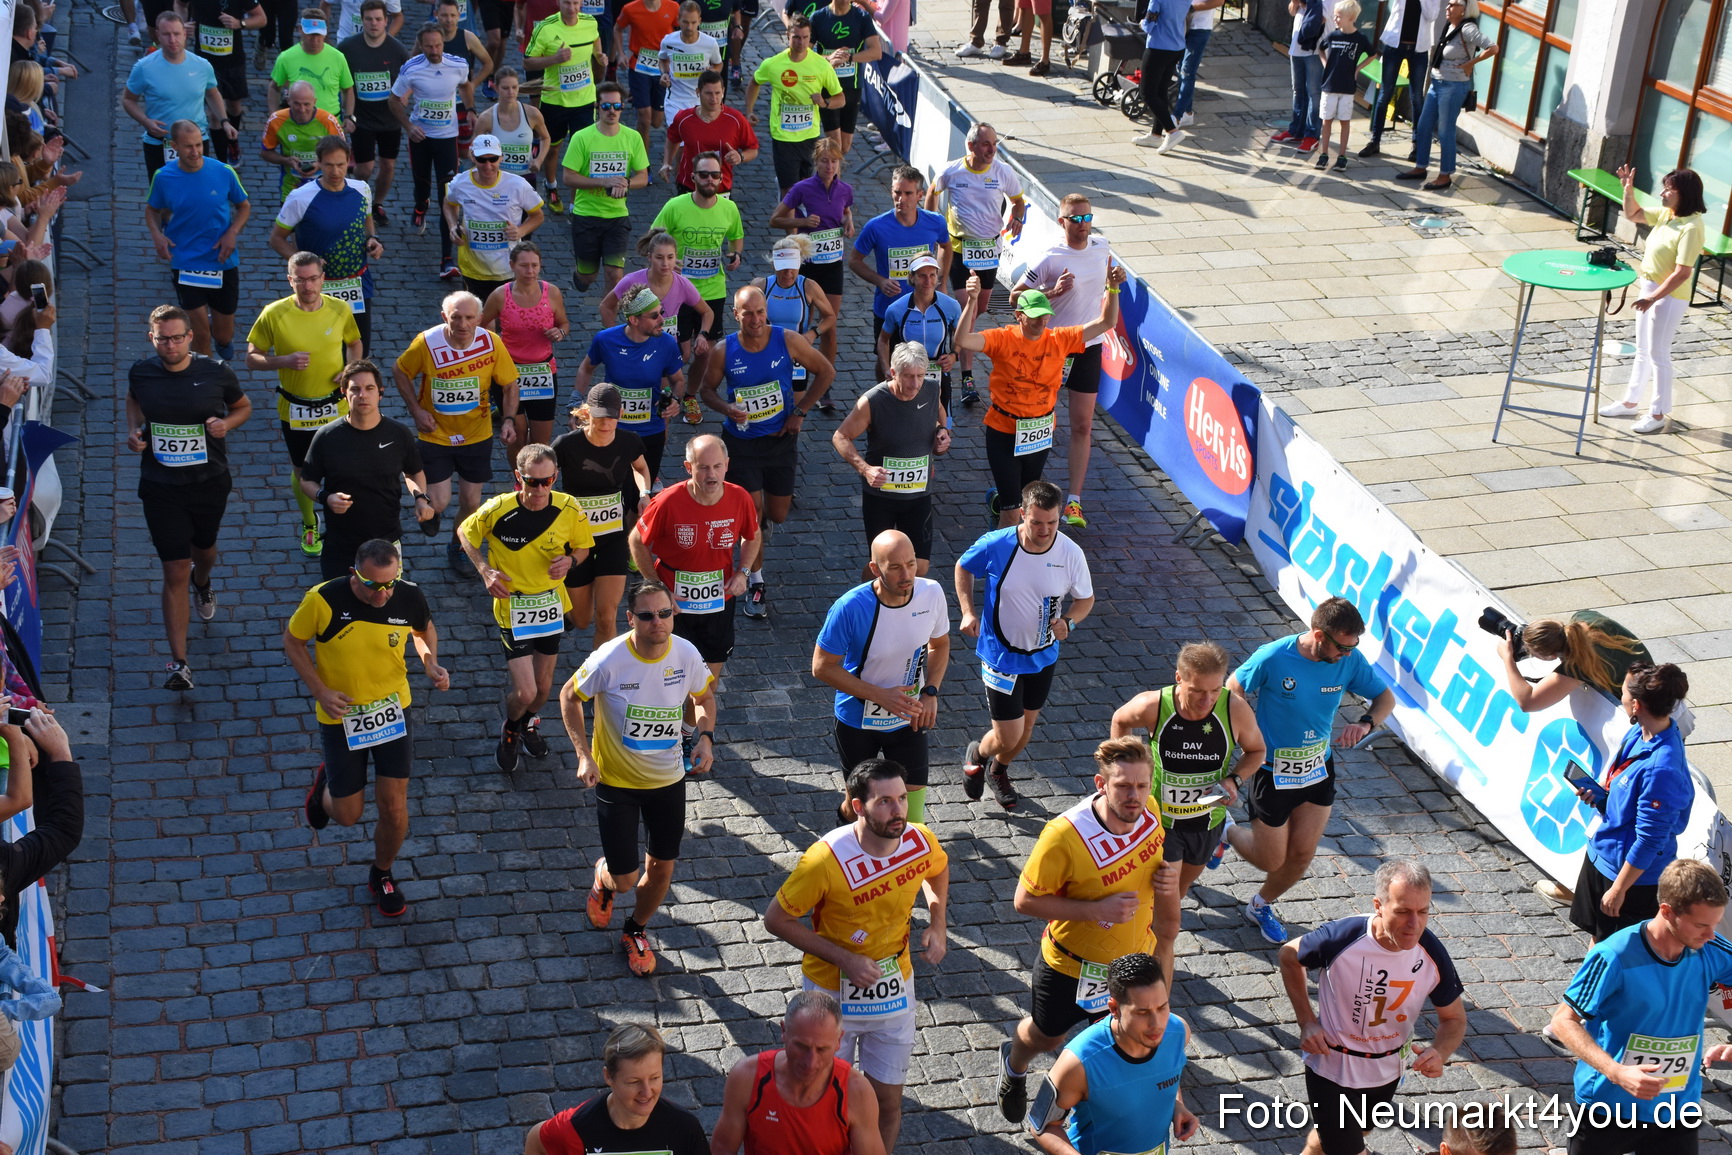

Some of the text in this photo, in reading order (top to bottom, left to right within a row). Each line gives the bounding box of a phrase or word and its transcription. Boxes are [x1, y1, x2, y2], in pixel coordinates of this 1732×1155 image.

[203, 35, 230, 46] 1229
[640, 55, 659, 67] 272
[677, 62, 702, 72] 1142
[560, 62, 588, 74] BOCK
[358, 73, 388, 82] BOCK
[563, 71, 589, 84] 2095
[359, 81, 388, 92] 2823
[421, 101, 451, 110] BOCK
[422, 109, 450, 120] 2297
[785, 113, 811, 123] 2116
[501, 153, 526, 164] 299
[594, 162, 623, 173] 2542
[472, 231, 504, 243] 2353
[815, 239, 841, 253] 2428
[967, 249, 994, 260] 3000
[686, 258, 717, 269] 2543
[434, 378, 477, 390] BOCK
[1149, 363, 1170, 393] ONLINE
[437, 390, 475, 403] 2842
[737, 383, 776, 397] BOCK
[621, 400, 647, 412] 134
[745, 394, 778, 412] 1133
[1146, 389, 1167, 420] MOBILE
[295, 405, 332, 419] 1193
[748, 408, 776, 420] JOCHEN
[300, 418, 329, 427] STEFAN
[1020, 415, 1054, 429] BOCK
[155, 424, 200, 436] BOCK
[1020, 427, 1051, 444] 2609
[1189, 382, 1247, 481] Hervis
[158, 438, 199, 453] 2672
[1018, 440, 1050, 452] CHRISTIAN
[163, 454, 197, 463] MARCEL
[1195, 439, 1219, 471] SPORTS
[885, 457, 925, 469] BOCK
[888, 469, 923, 483] 1197
[579, 496, 616, 507] BOCK
[585, 507, 618, 523] 406
[500, 535, 519, 543] Heinz
[679, 571, 721, 584] BOCK
[680, 584, 719, 600] 3006
[518, 594, 561, 608] BOCK
[687, 602, 713, 610] JOSEF
[517, 606, 559, 625] 2798
[1320, 685, 1343, 693] BOCK
[350, 707, 398, 733] 2608
[631, 707, 680, 720] BOCK
[358, 727, 397, 743] MARKUS
[629, 722, 675, 738] 2794
[1303, 729, 1317, 739] 18.
[1182, 741, 1203, 750] DAV
[1280, 743, 1323, 758] BOCK
[1164, 750, 1220, 761] Röthenbach
[1280, 755, 1321, 775] 2550
[1166, 774, 1216, 786] BOCK
[1278, 769, 1322, 784] CHRISTIAN
[1168, 786, 1212, 804] 122
[1167, 805, 1211, 814] REINHAR
[1101, 834, 1165, 887] MAX BÖGL
[853, 859, 933, 906] MAX BÖGL
[848, 977, 901, 1001] 2409
[1362, 978, 1374, 1005] LAUF
[847, 1000, 903, 1014] MAXIMILIAN
[1352, 994, 1363, 1025] STADT
[1635, 1039, 1691, 1052] BOCK
